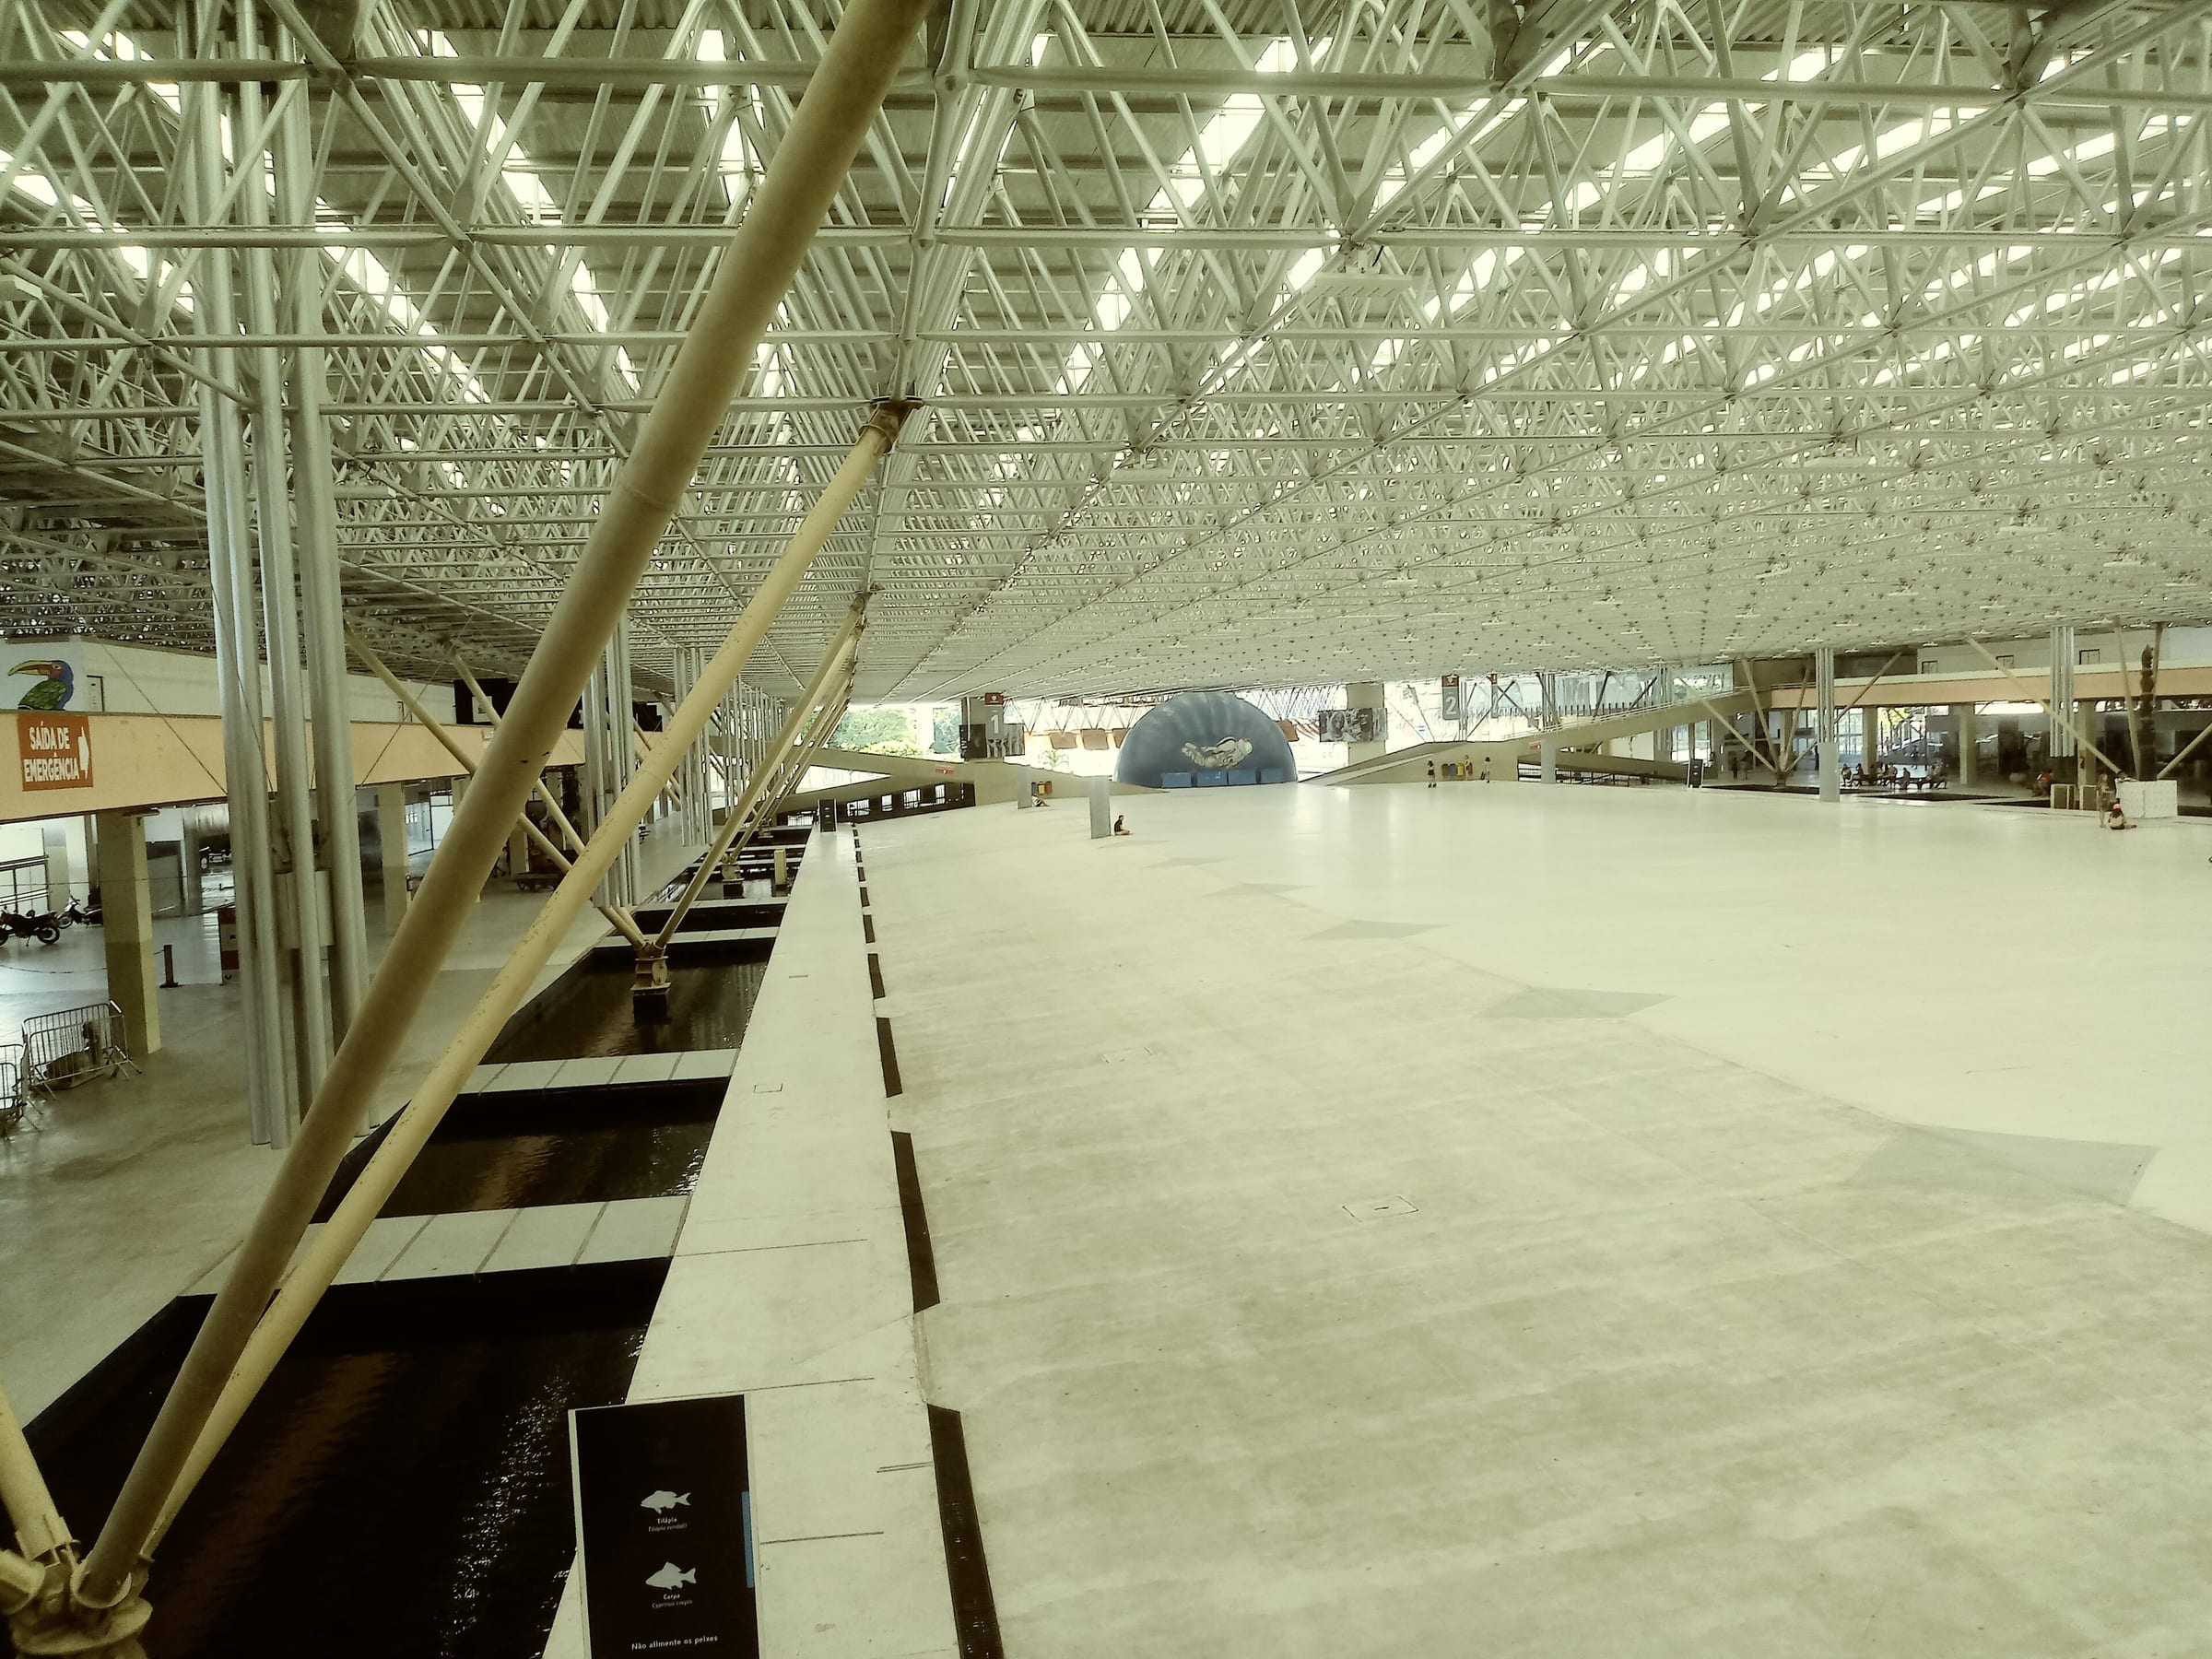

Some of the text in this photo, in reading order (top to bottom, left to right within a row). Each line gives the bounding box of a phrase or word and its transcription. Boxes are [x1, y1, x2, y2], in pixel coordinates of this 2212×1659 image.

[1445, 696, 1456, 715] 2
[991, 714, 999, 734] 1
[29, 720, 71, 750] SAÍDA DE
[23, 751, 80, 782] EMERGÊNCIA
[631, 1642, 646, 1651] Não
[649, 1640, 682, 1649] alimente
[694, 1634, 718, 1645] peixes
